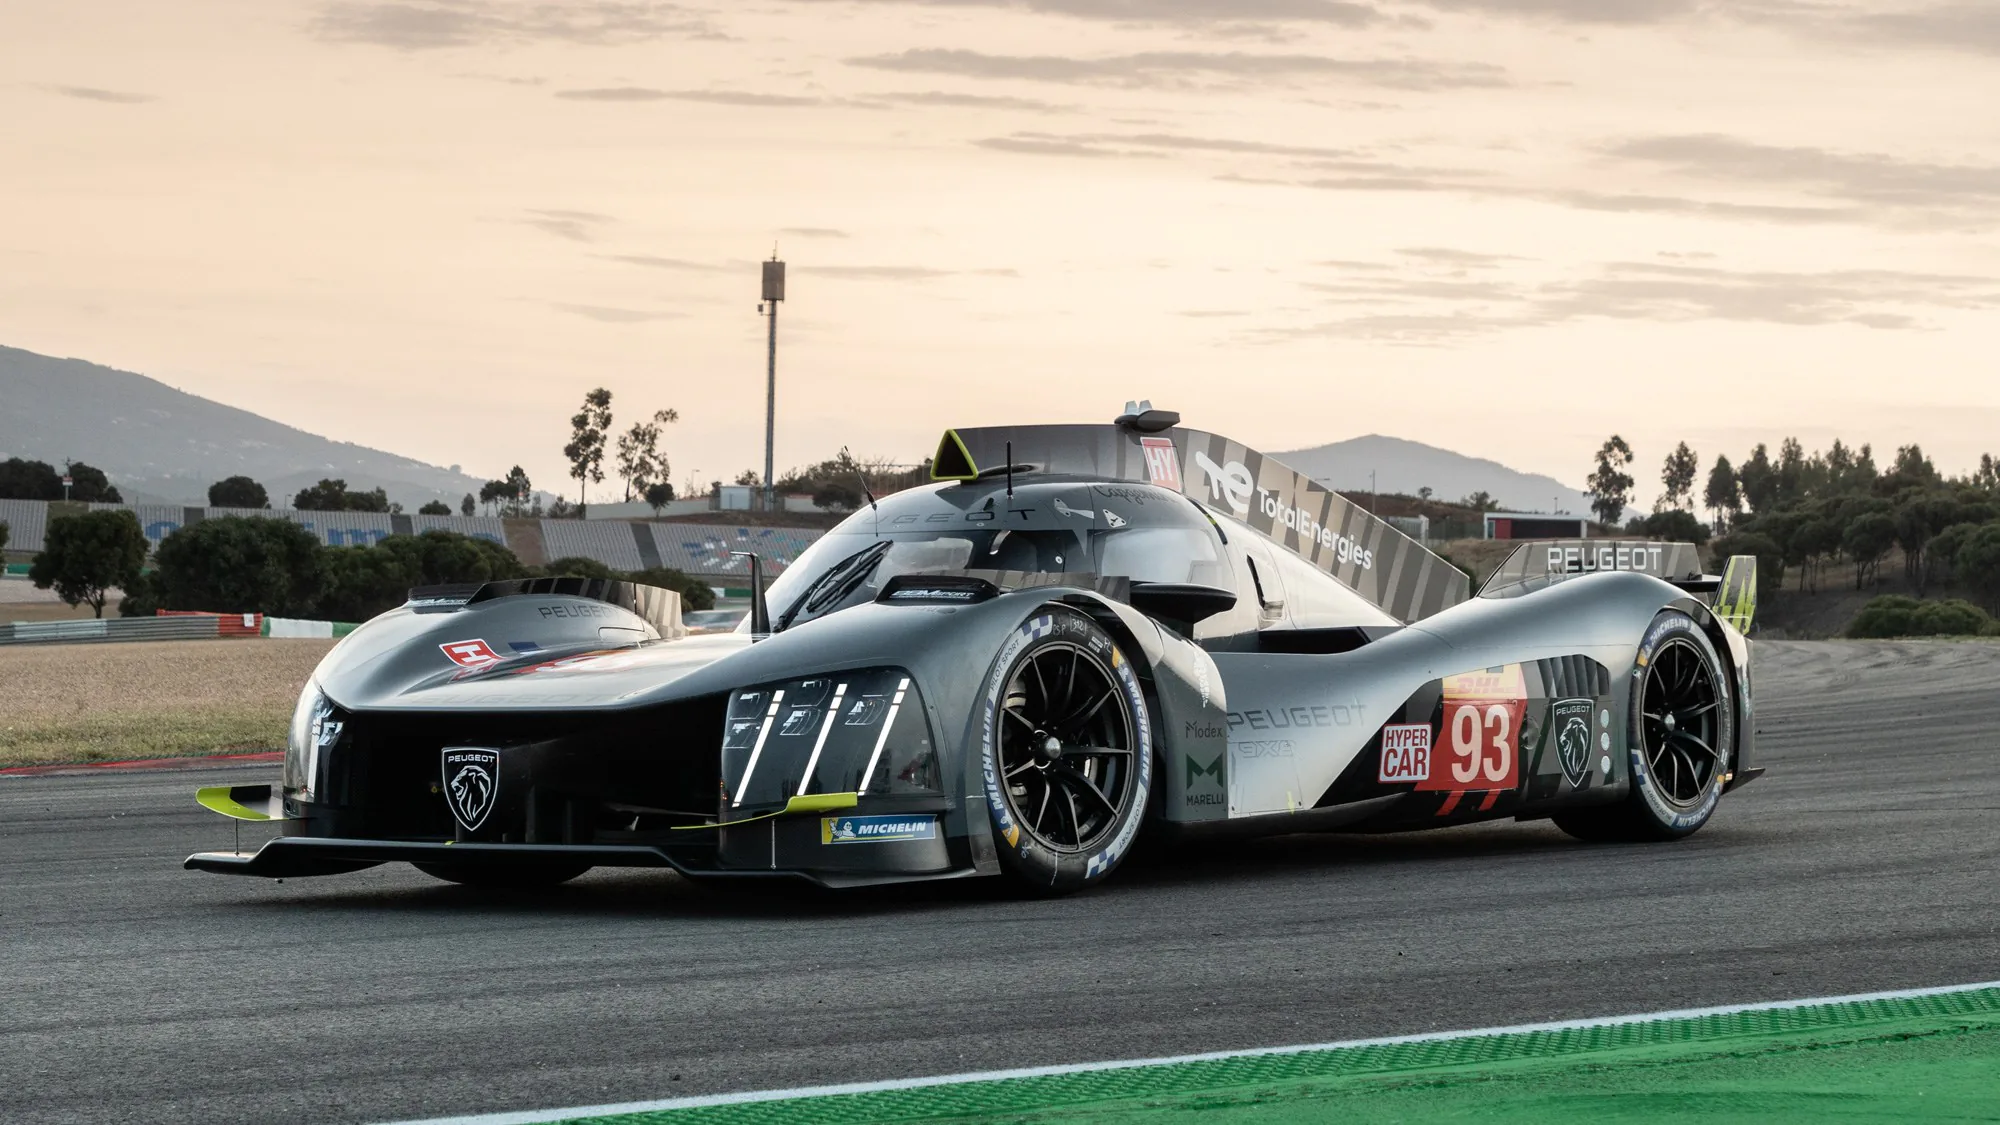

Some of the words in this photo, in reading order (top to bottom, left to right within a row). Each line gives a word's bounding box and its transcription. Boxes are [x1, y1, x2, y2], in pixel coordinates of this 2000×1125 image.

[1146, 447, 1174, 481] HY
[1093, 484, 1178, 505] Capgemin
[864, 508, 1036, 525] UGEOT
[1256, 485, 1373, 570] TotalEnergies
[1547, 547, 1662, 571] PEUGEOT
[1650, 618, 1689, 647] MICHELIN
[990, 664, 1003, 692] PILOT
[1001, 639, 1020, 665] SPORT
[1456, 677, 1510, 694] DHL
[1227, 703, 1367, 731] PEUGEOT
[1556, 705, 1591, 716] PEUGEOT
[1127, 681, 1151, 780] MICHELIN
[1185, 720, 1223, 739] Modex
[1385, 728, 1428, 748] HYPER
[1451, 703, 1511, 783] 93
[447, 754, 496, 763] PEUGEOT
[982, 708, 1005, 810] MICHELIN
[1383, 748, 1427, 777] CAR
[1186, 793, 1224, 806] MARELLI
[858, 821, 927, 835] MICHELIN
[1118, 822, 1136, 850] SPORT
